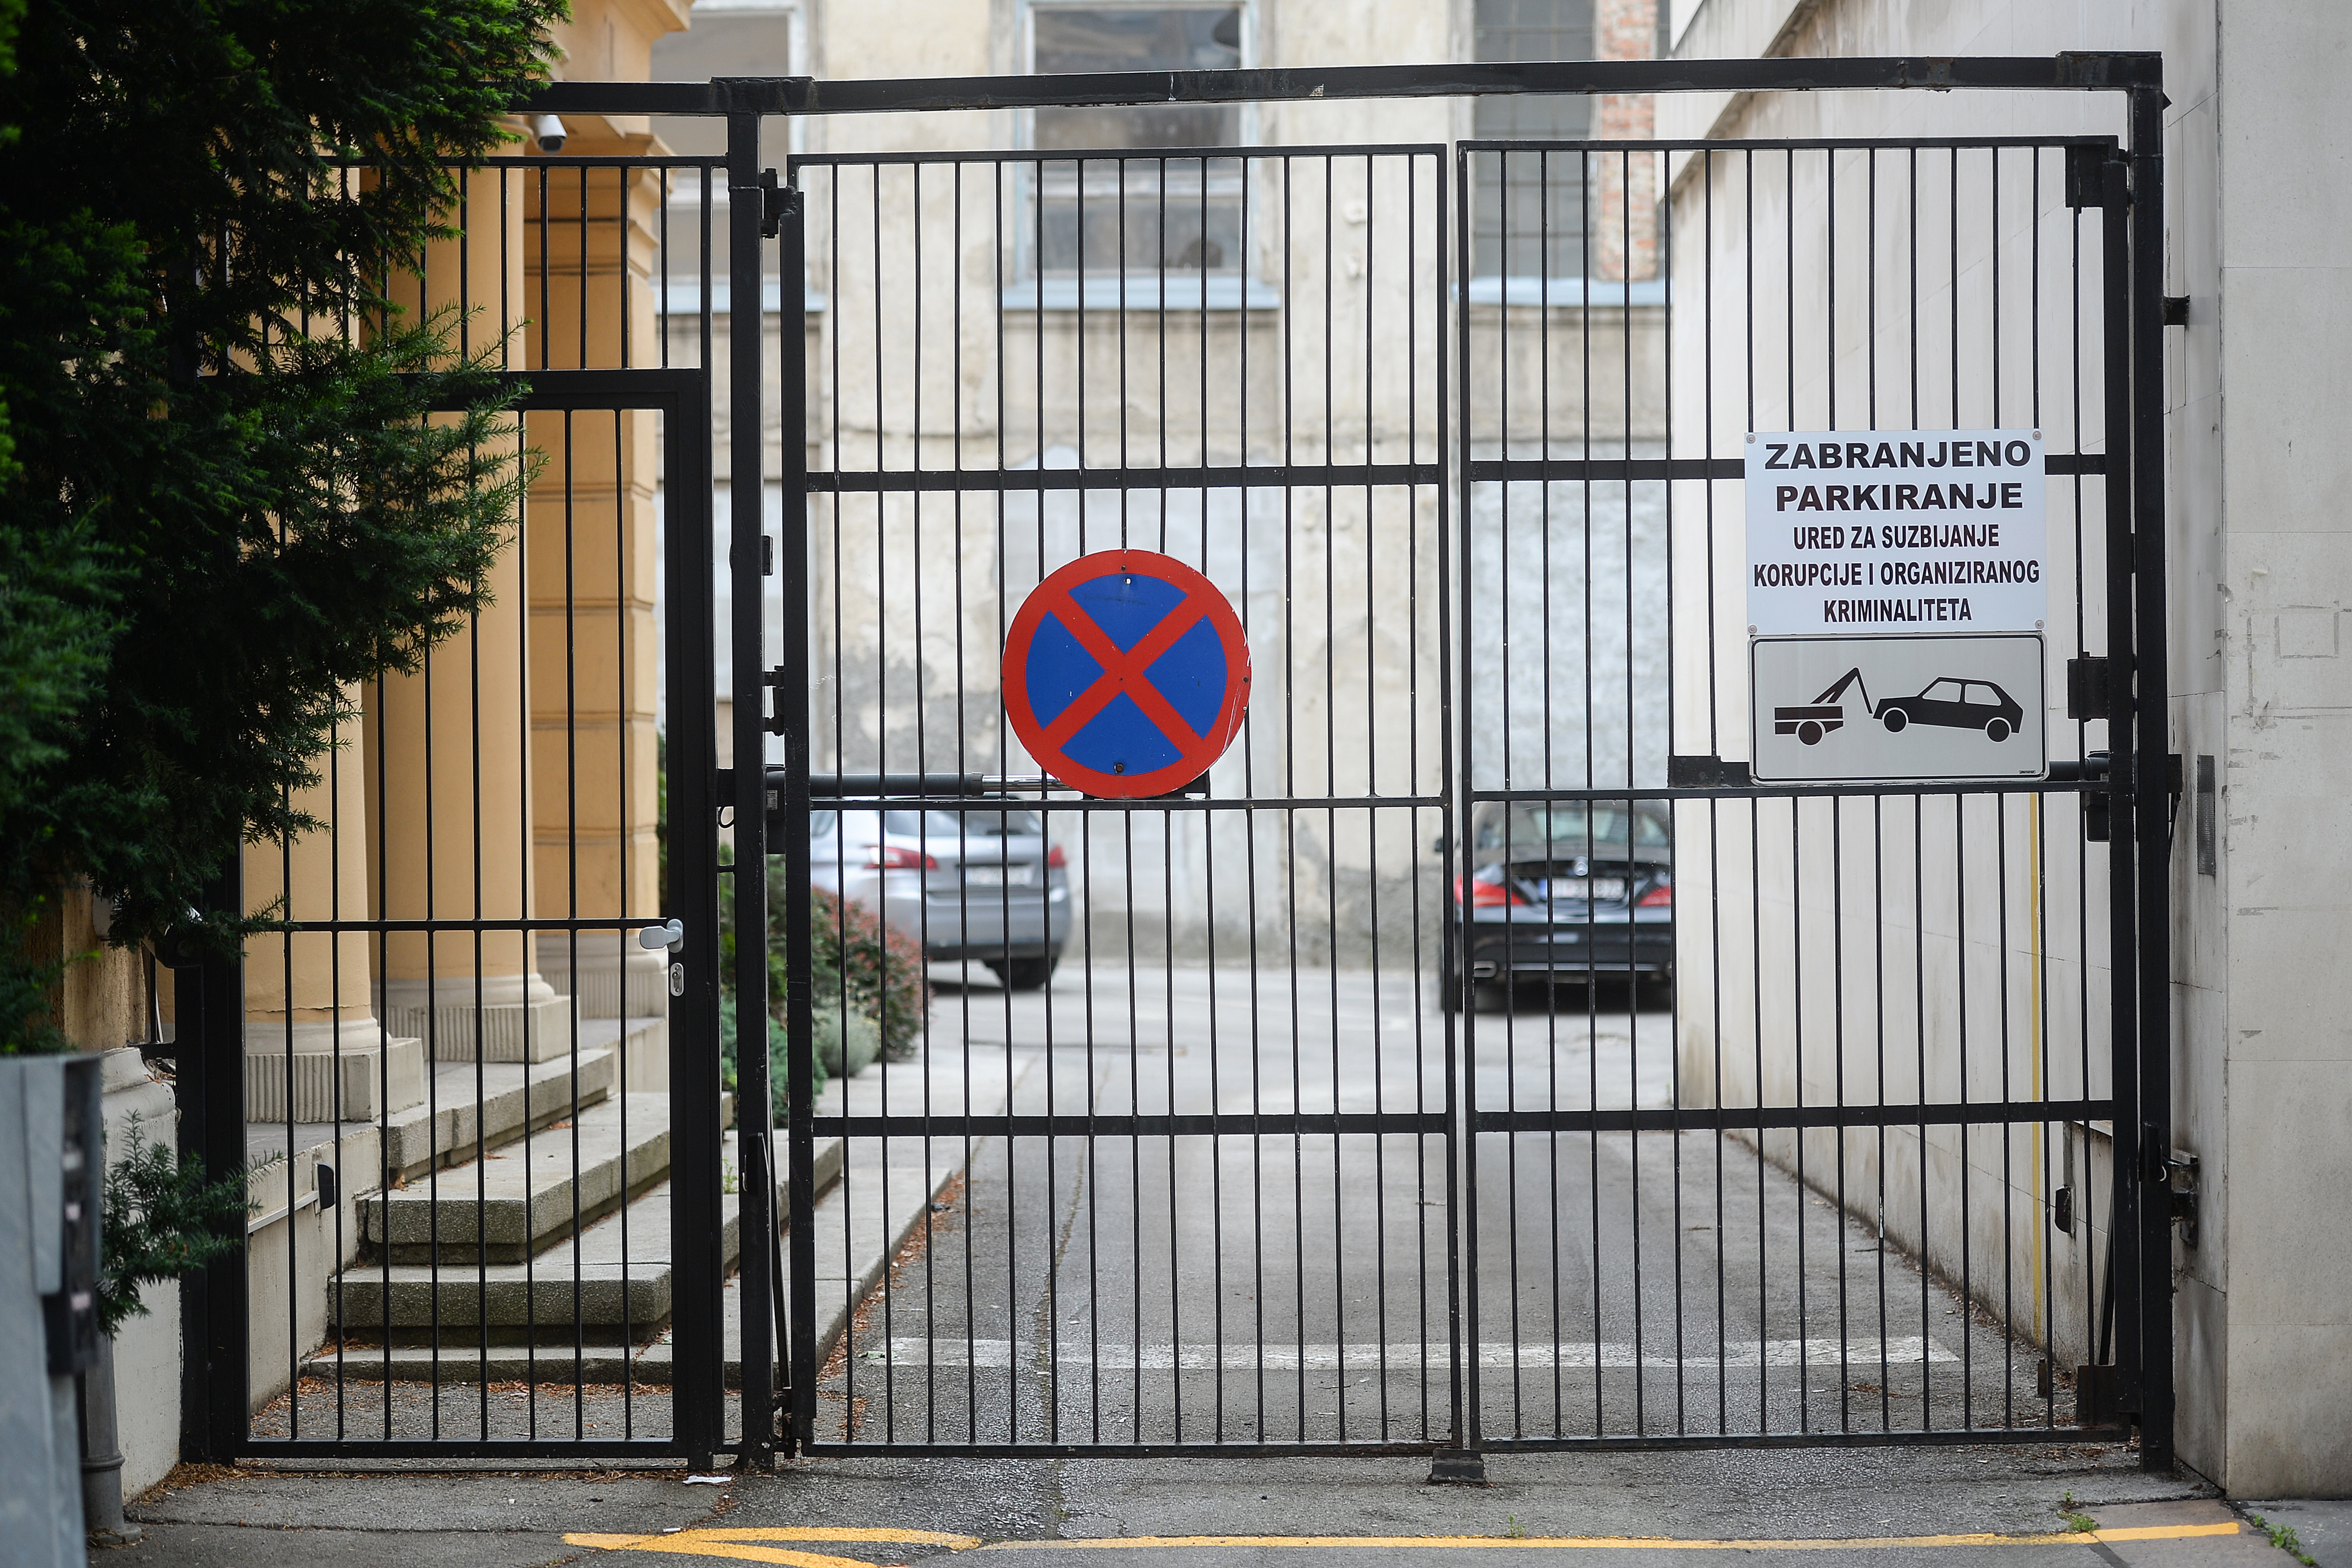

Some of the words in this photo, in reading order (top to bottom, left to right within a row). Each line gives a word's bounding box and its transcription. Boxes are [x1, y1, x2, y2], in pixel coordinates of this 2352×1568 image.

[1765, 440, 2031, 470] ZABRANJENO
[1776, 483, 2023, 512] PARKIRANJE
[1793, 526, 1845, 550] URED
[1850, 526, 1876, 549] ZA
[1882, 524, 1999, 549] SUZBIJANJE
[1754, 563, 1862, 587] KORUPCIJE
[1869, 563, 1873, 586] I
[1880, 560, 2039, 586] ORGANIZIRANOG
[1824, 598, 1972, 623] KRIMINALITETA
